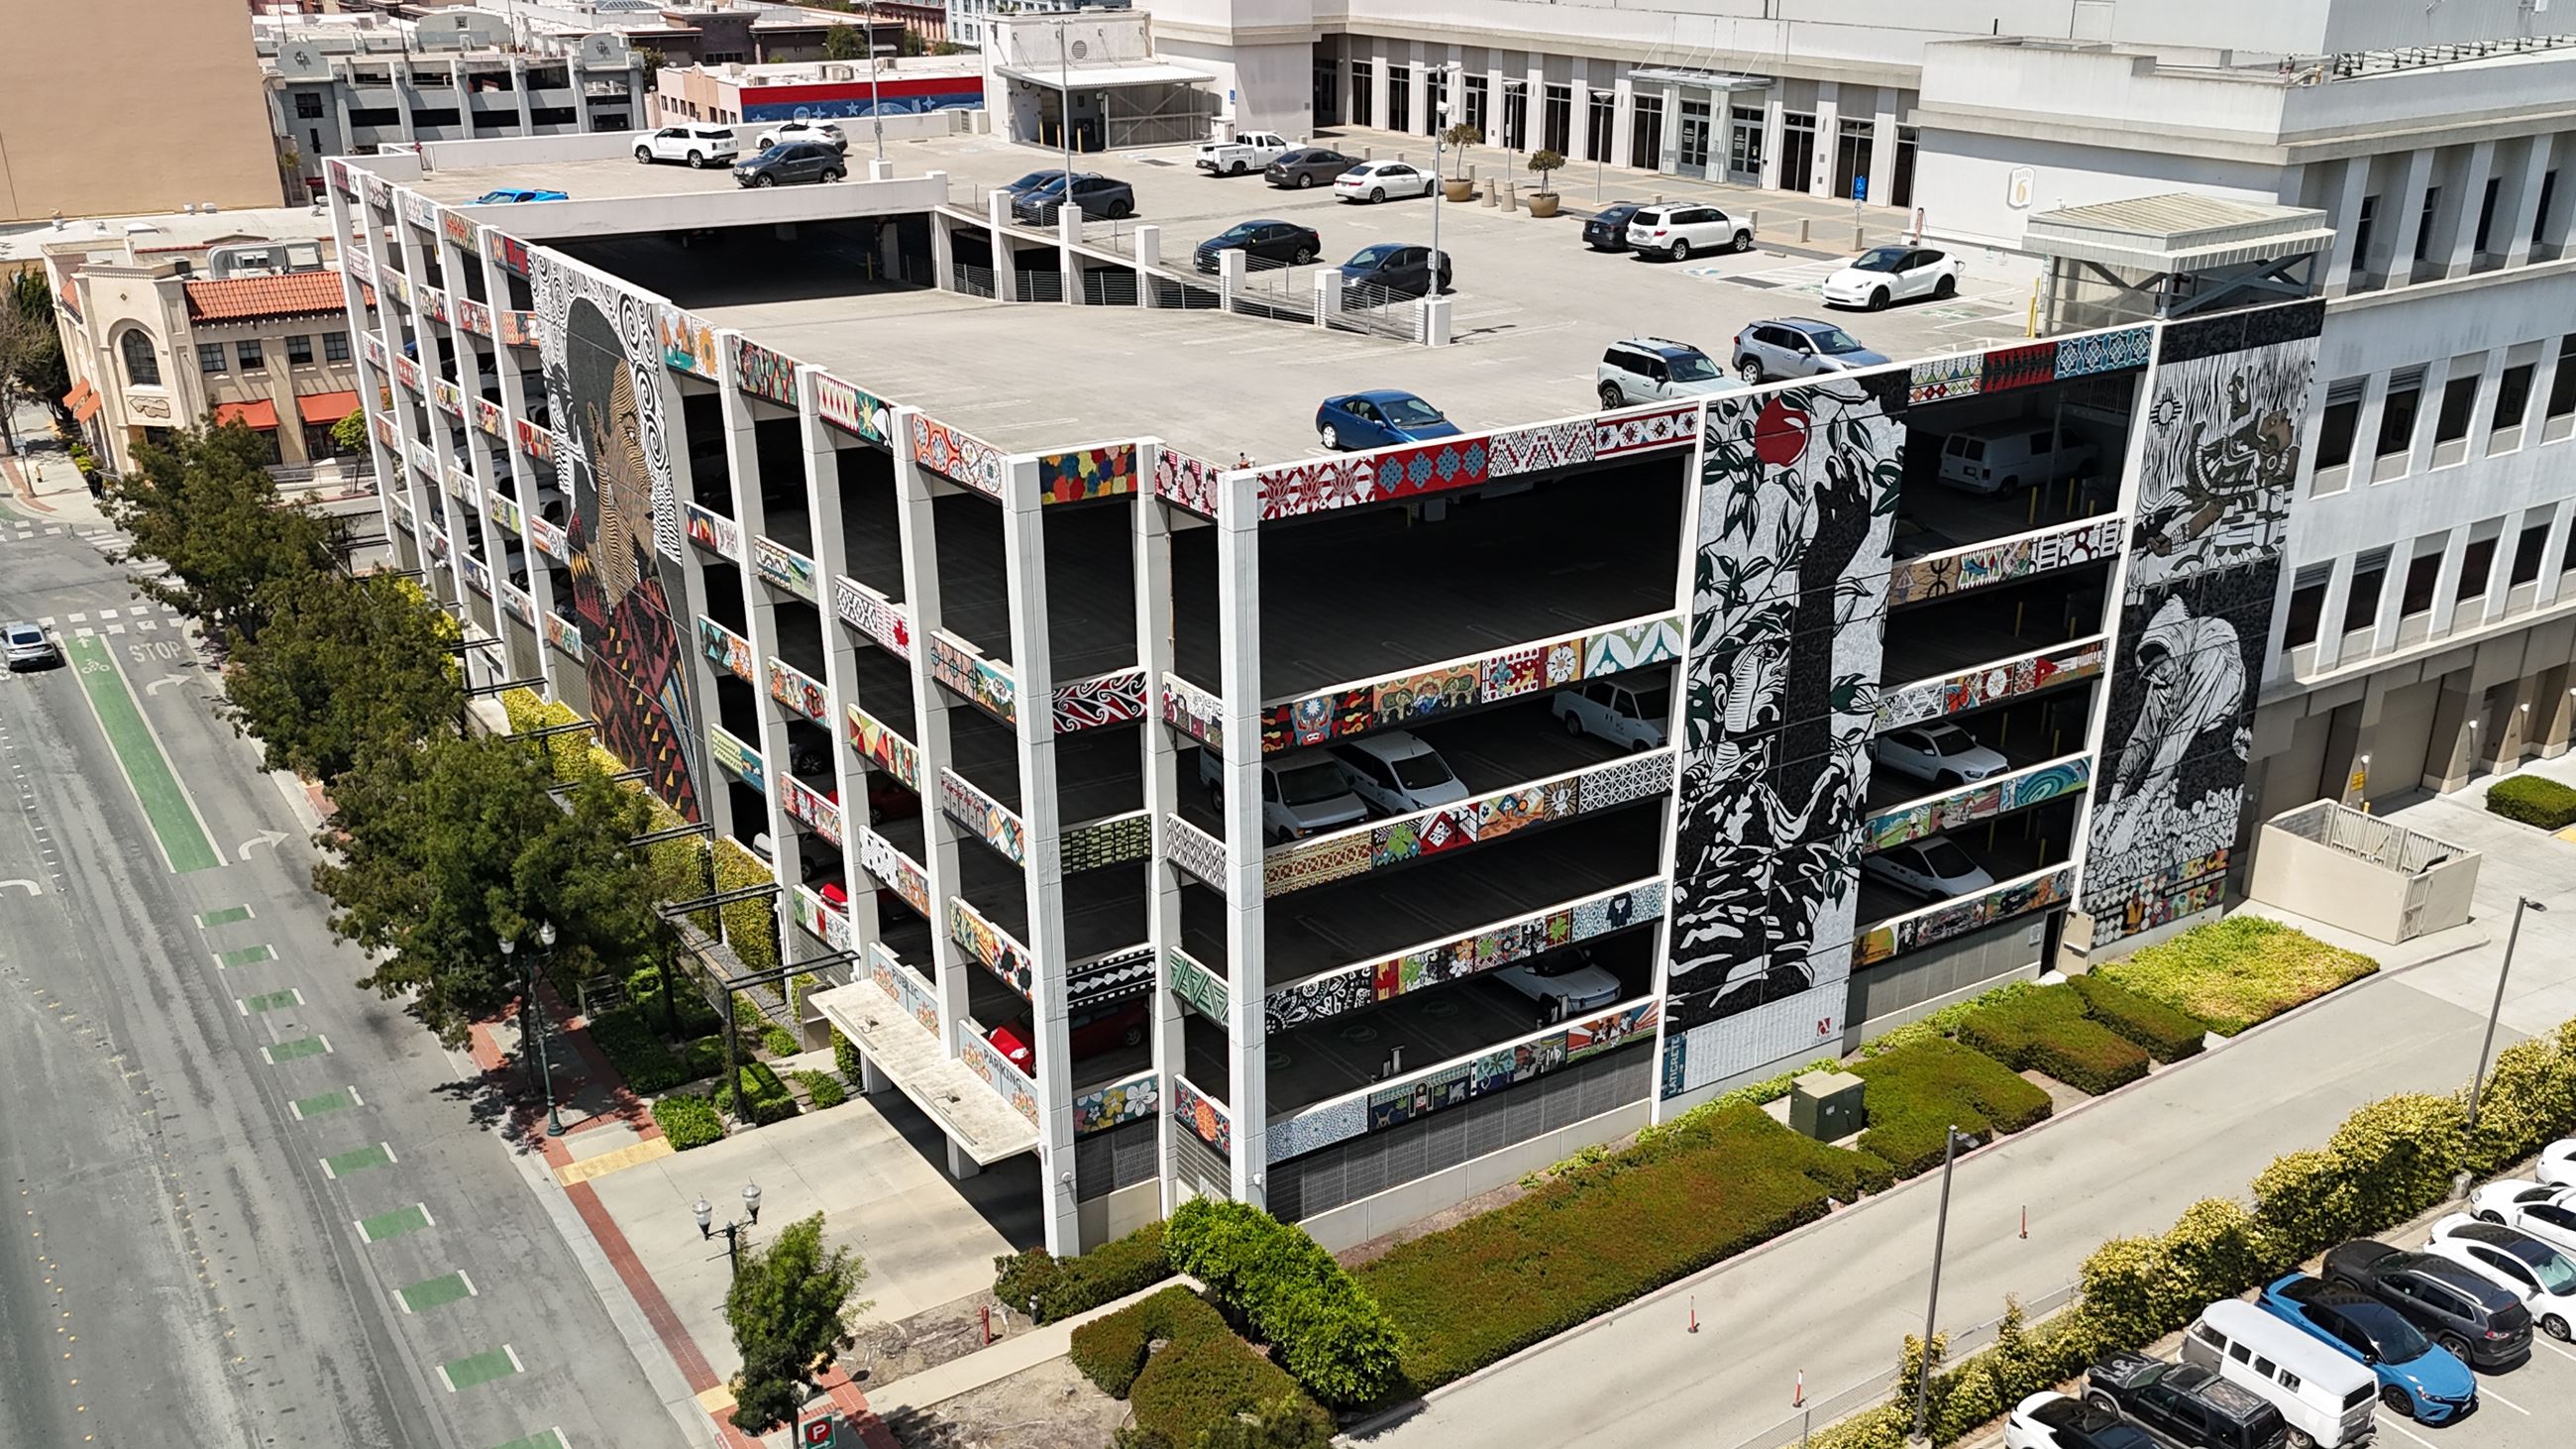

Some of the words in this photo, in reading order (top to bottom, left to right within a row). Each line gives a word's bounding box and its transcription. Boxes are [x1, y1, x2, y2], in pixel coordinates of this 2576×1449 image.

[2015, 178, 2027, 203] 6
[128, 640, 181, 663] STOP
[892, 967, 919, 1000] PUBLIC
[983, 1048, 1022, 1091] PARKING
[1668, 1036, 1680, 1095] LATICRETE
[812, 1423, 826, 1440] P
